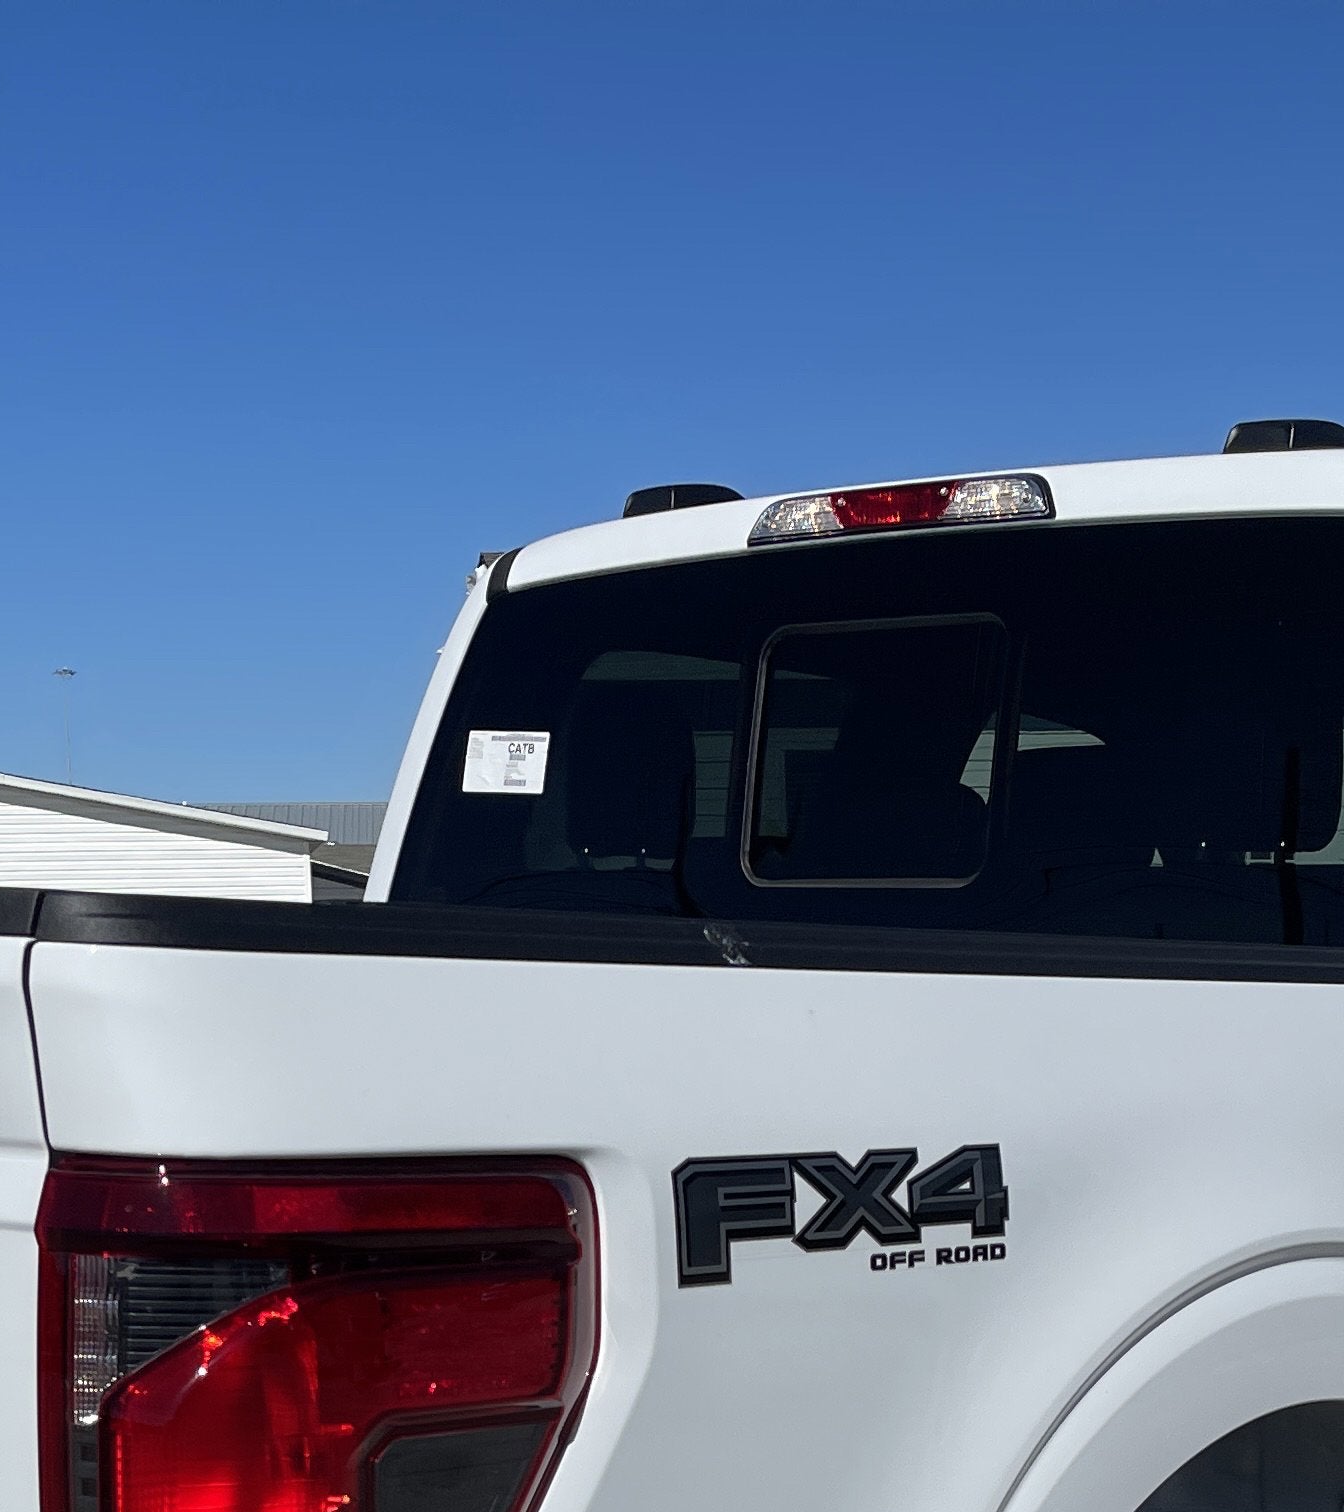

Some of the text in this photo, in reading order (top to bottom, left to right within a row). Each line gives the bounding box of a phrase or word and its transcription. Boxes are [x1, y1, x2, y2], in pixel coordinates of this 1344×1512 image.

[670, 1142, 1010, 1290] FX4
[869, 1242, 1007, 1272] OFF ROAD
